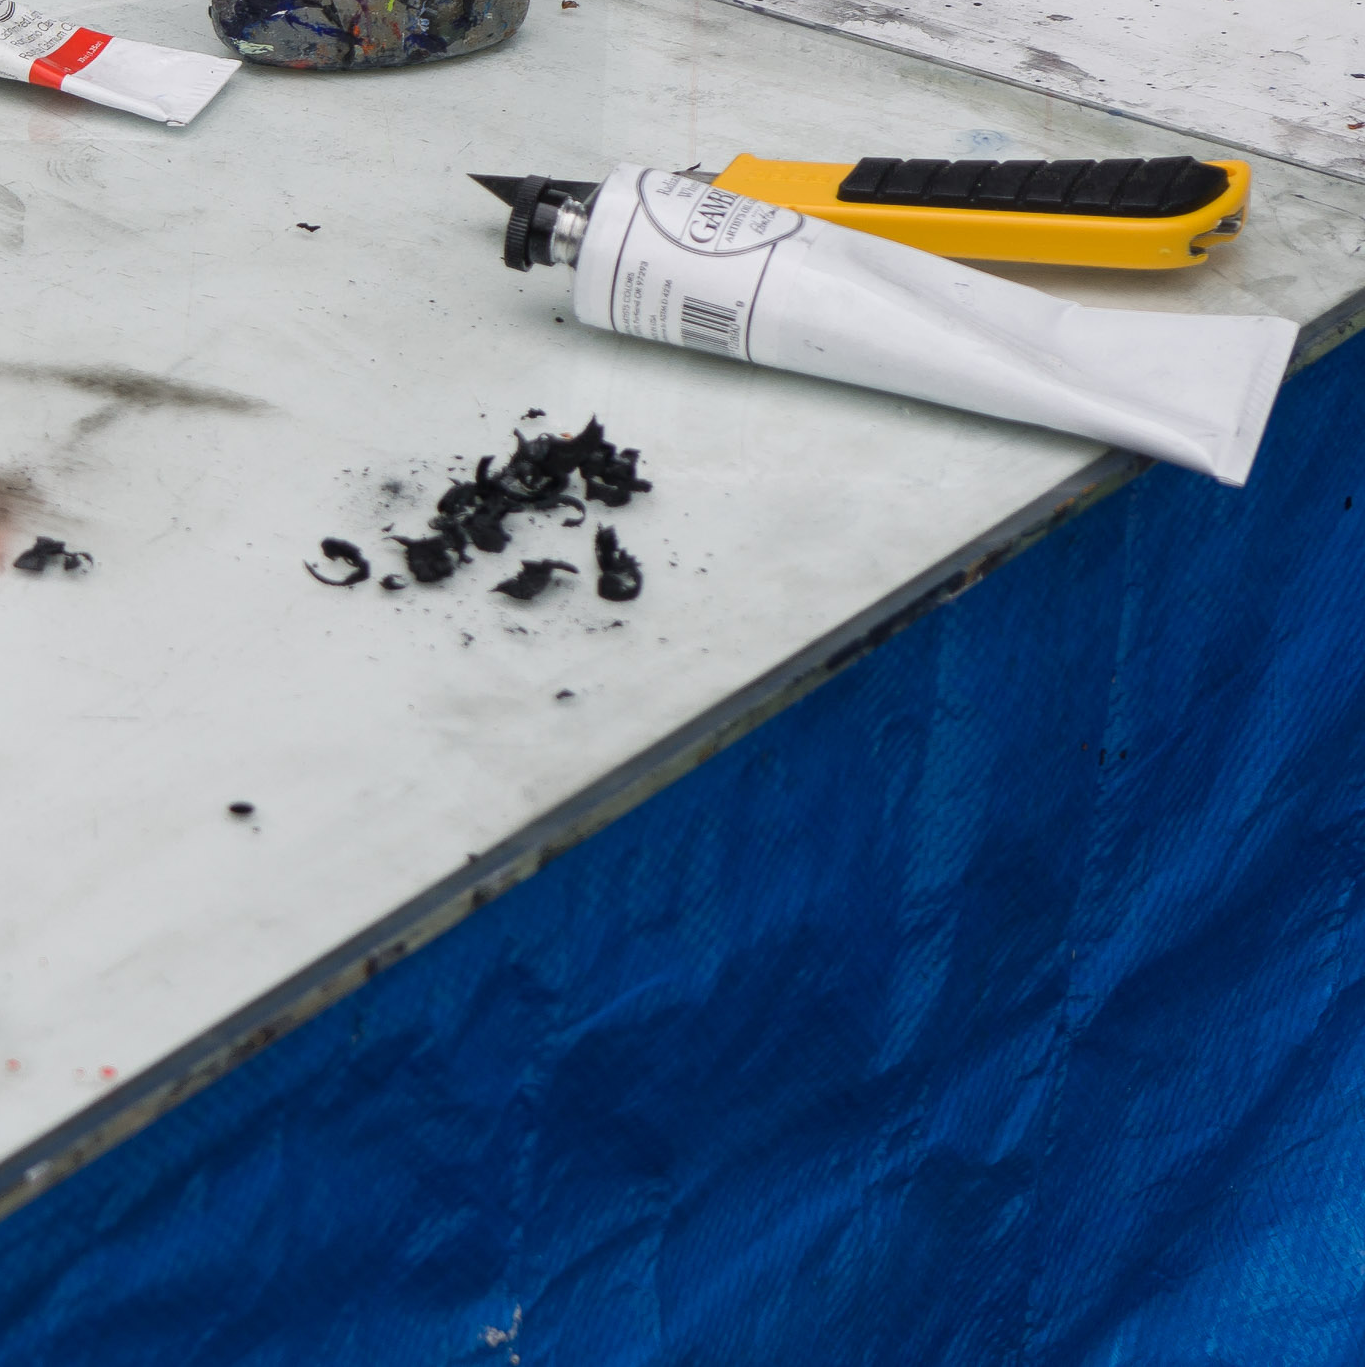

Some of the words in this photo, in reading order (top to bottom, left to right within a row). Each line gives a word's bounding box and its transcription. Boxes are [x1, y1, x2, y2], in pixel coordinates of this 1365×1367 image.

[637, 260, 648, 286] 97293
[624, 272, 634, 302] COLORS
[663, 279, 672, 298] 4236
